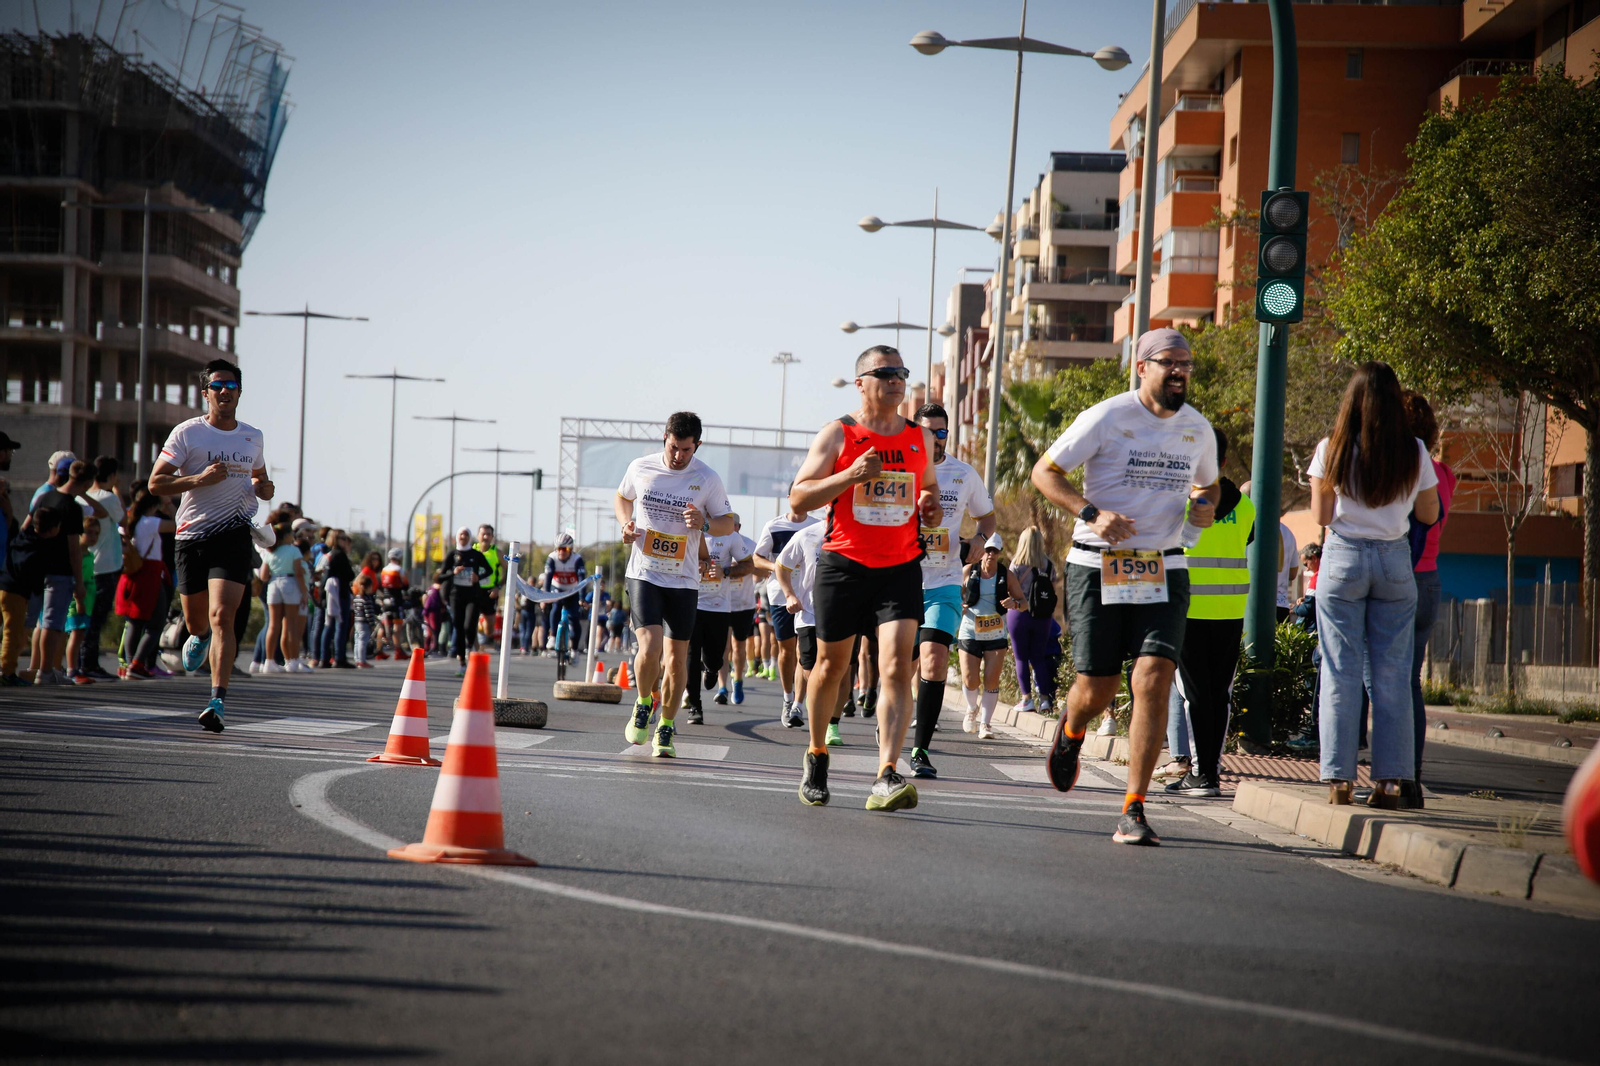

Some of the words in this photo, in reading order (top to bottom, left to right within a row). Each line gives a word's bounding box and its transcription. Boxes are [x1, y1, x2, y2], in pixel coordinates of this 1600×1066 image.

[1128, 449, 1156, 458] Medio
[1159, 451, 1191, 461] Maratón
[1127, 458, 1165, 468] Almería
[1166, 460, 1191, 471] 2024
[643, 488, 664, 498] Medio
[666, 493, 694, 503] Maratón
[863, 480, 907, 498] 1641
[642, 494, 671, 506] Almería
[671, 500, 688, 509] 202
[939, 494, 958, 502] 2024
[652, 538, 679, 554] 869
[1109, 558, 1159, 575] 1590
[978, 617, 1001, 629] 1859
